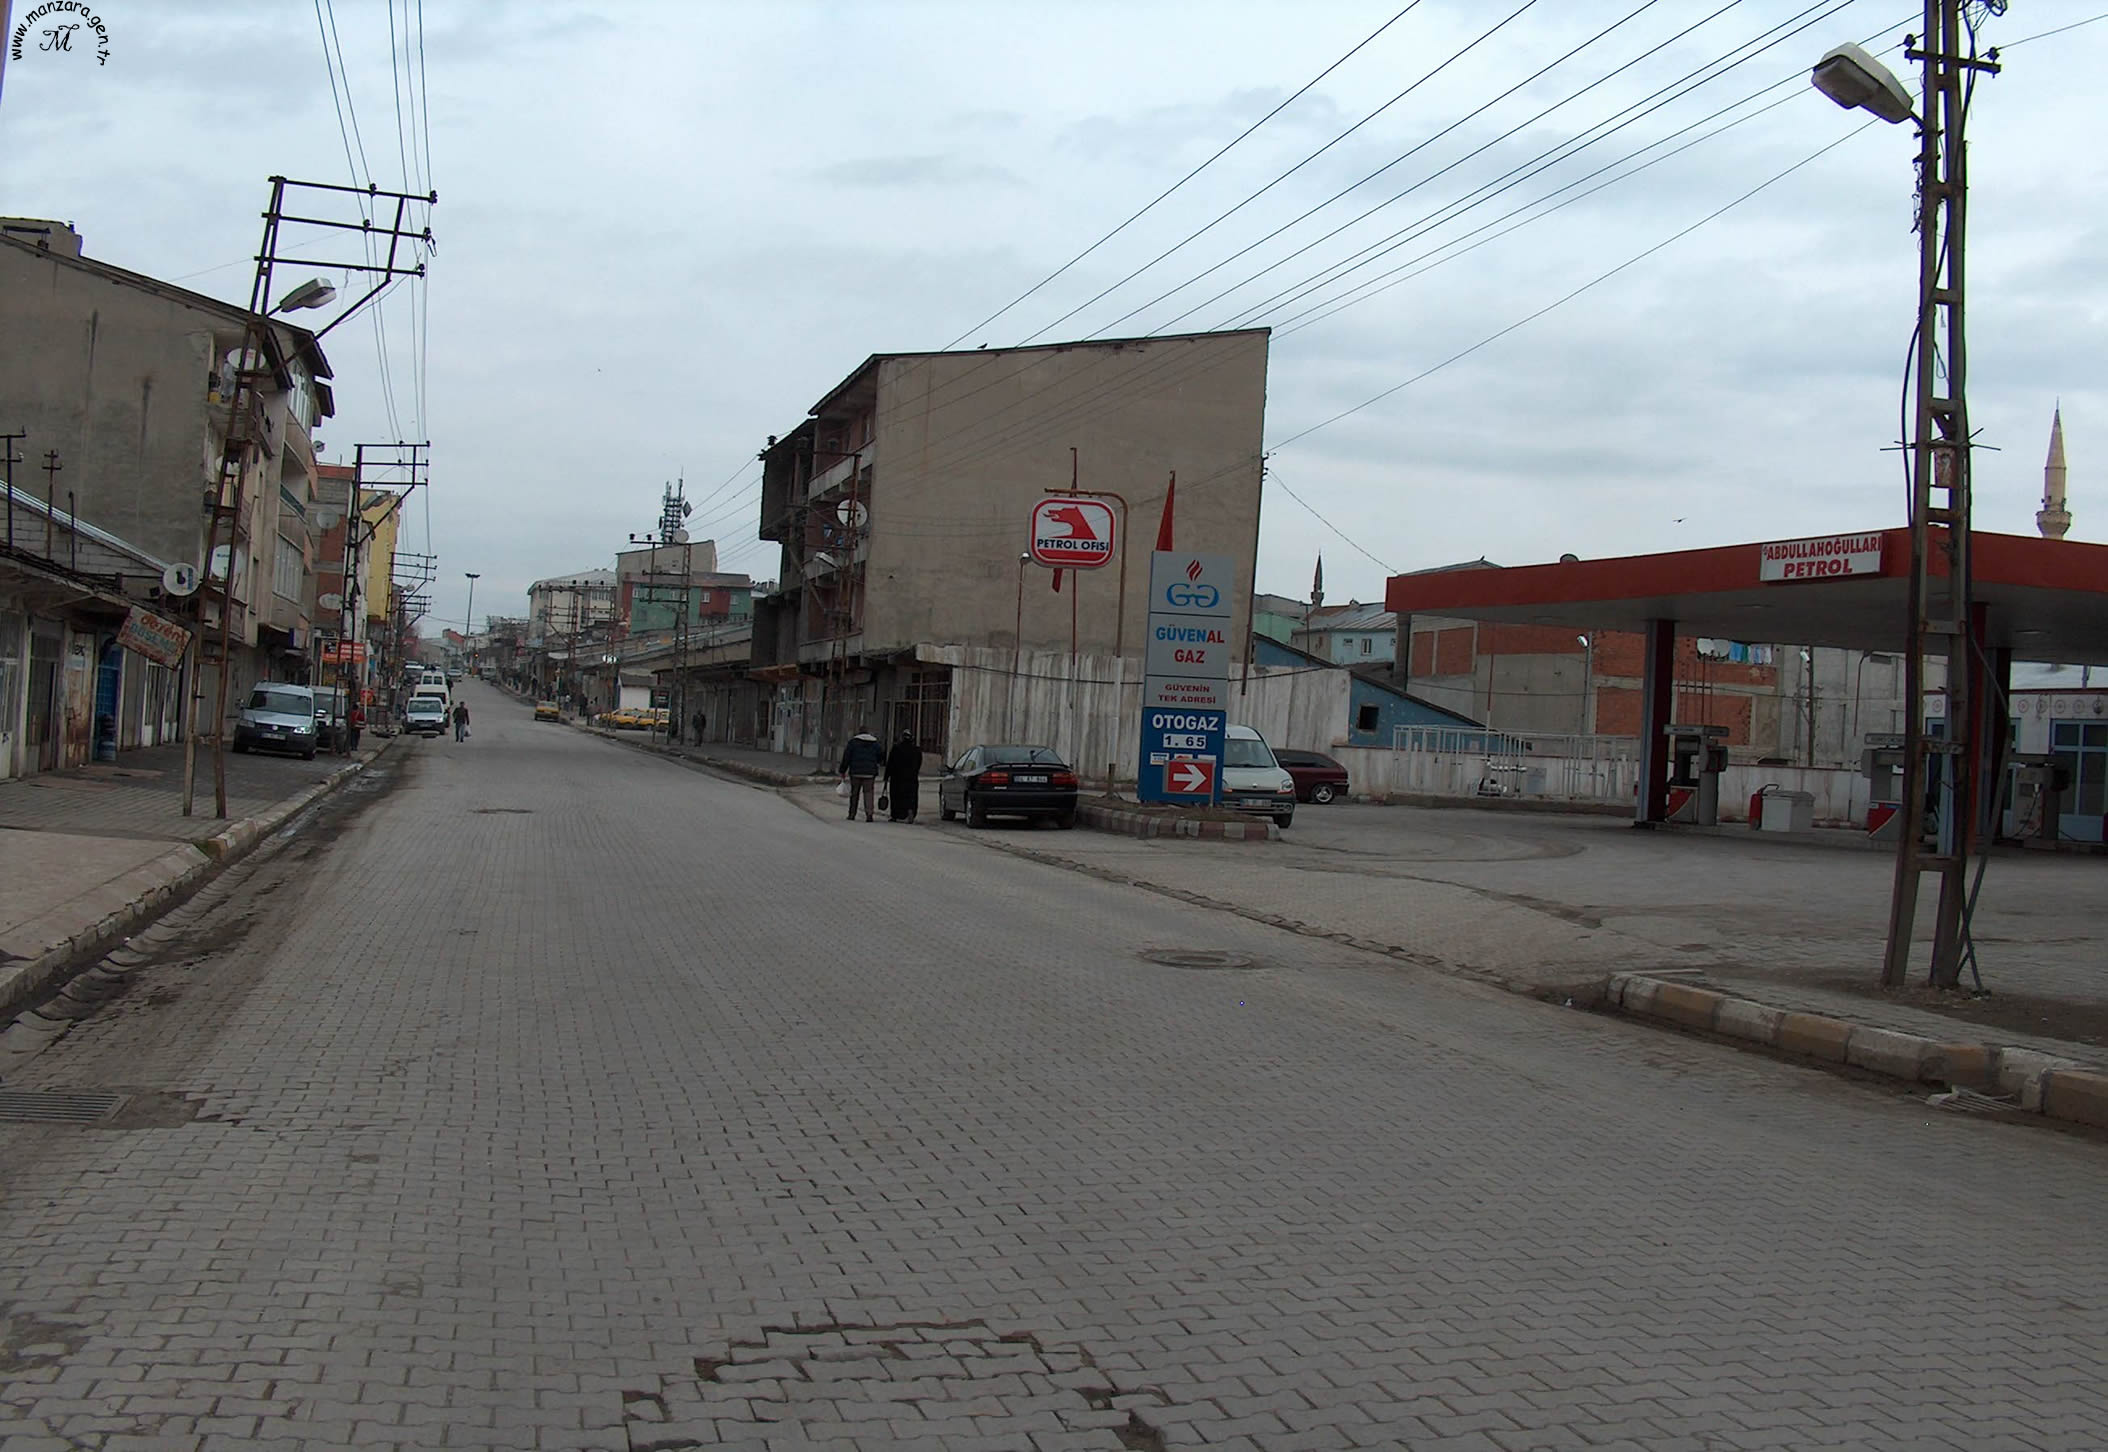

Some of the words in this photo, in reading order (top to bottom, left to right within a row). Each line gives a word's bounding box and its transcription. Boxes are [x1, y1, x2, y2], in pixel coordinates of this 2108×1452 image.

[1037, 538, 1078, 550] PETROL
[1783, 559, 1854, 578] PETROL
[1155, 624, 1225, 644] GÜVENAL
[1174, 649, 1205, 664] GAZ
[1164, 683, 1210, 692] GÜVENİN
[1158, 694, 1177, 702] TEK
[1180, 695, 1217, 704] ADRESİ
[1152, 714, 1219, 731] OTOGAZ
